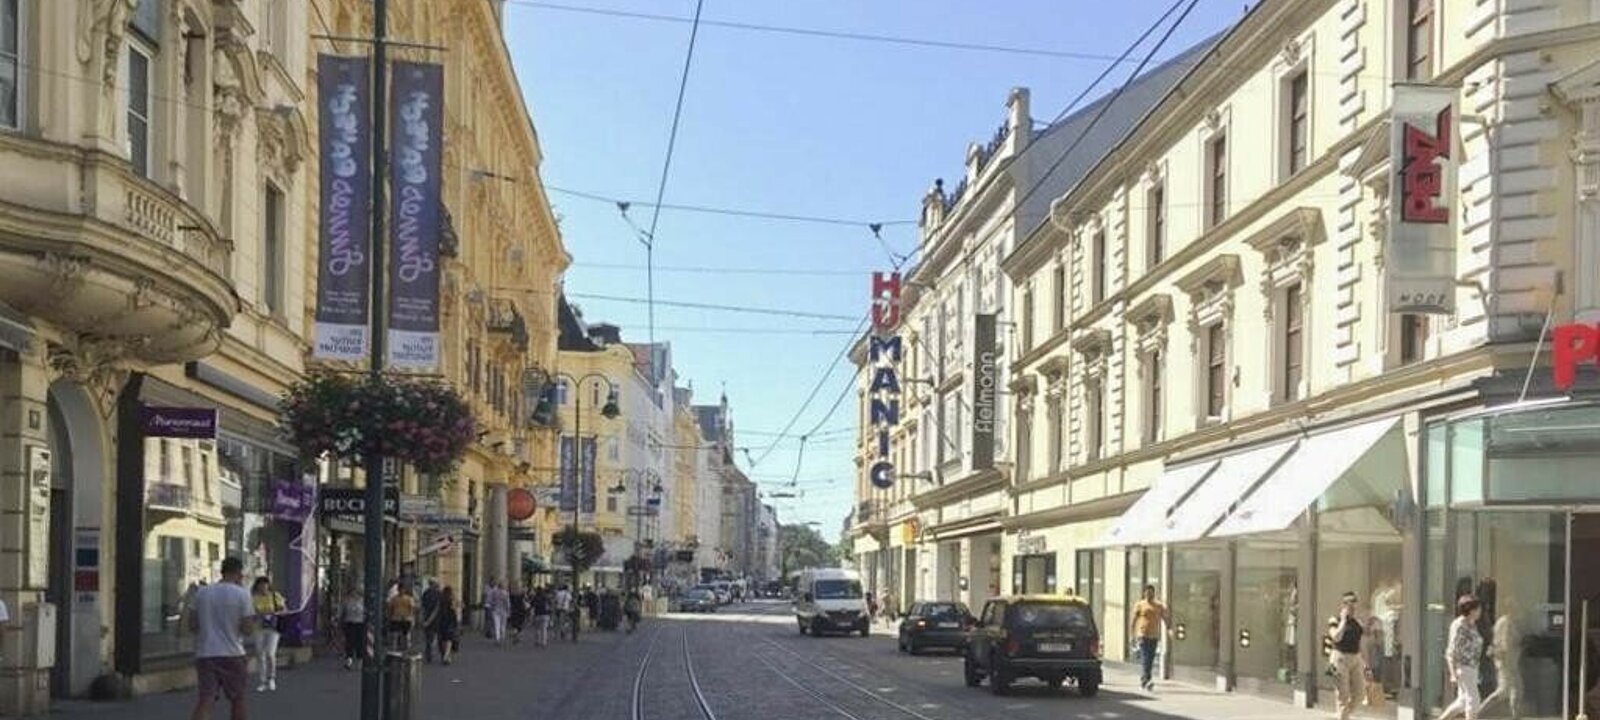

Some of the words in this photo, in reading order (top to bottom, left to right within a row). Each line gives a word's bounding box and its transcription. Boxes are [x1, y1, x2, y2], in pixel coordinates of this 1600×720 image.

[1399, 103, 1452, 224] PENZ
[869, 271, 901, 490] HUMANIC
[974, 351, 994, 433] fielmann
[1552, 323, 1600, 393] P
